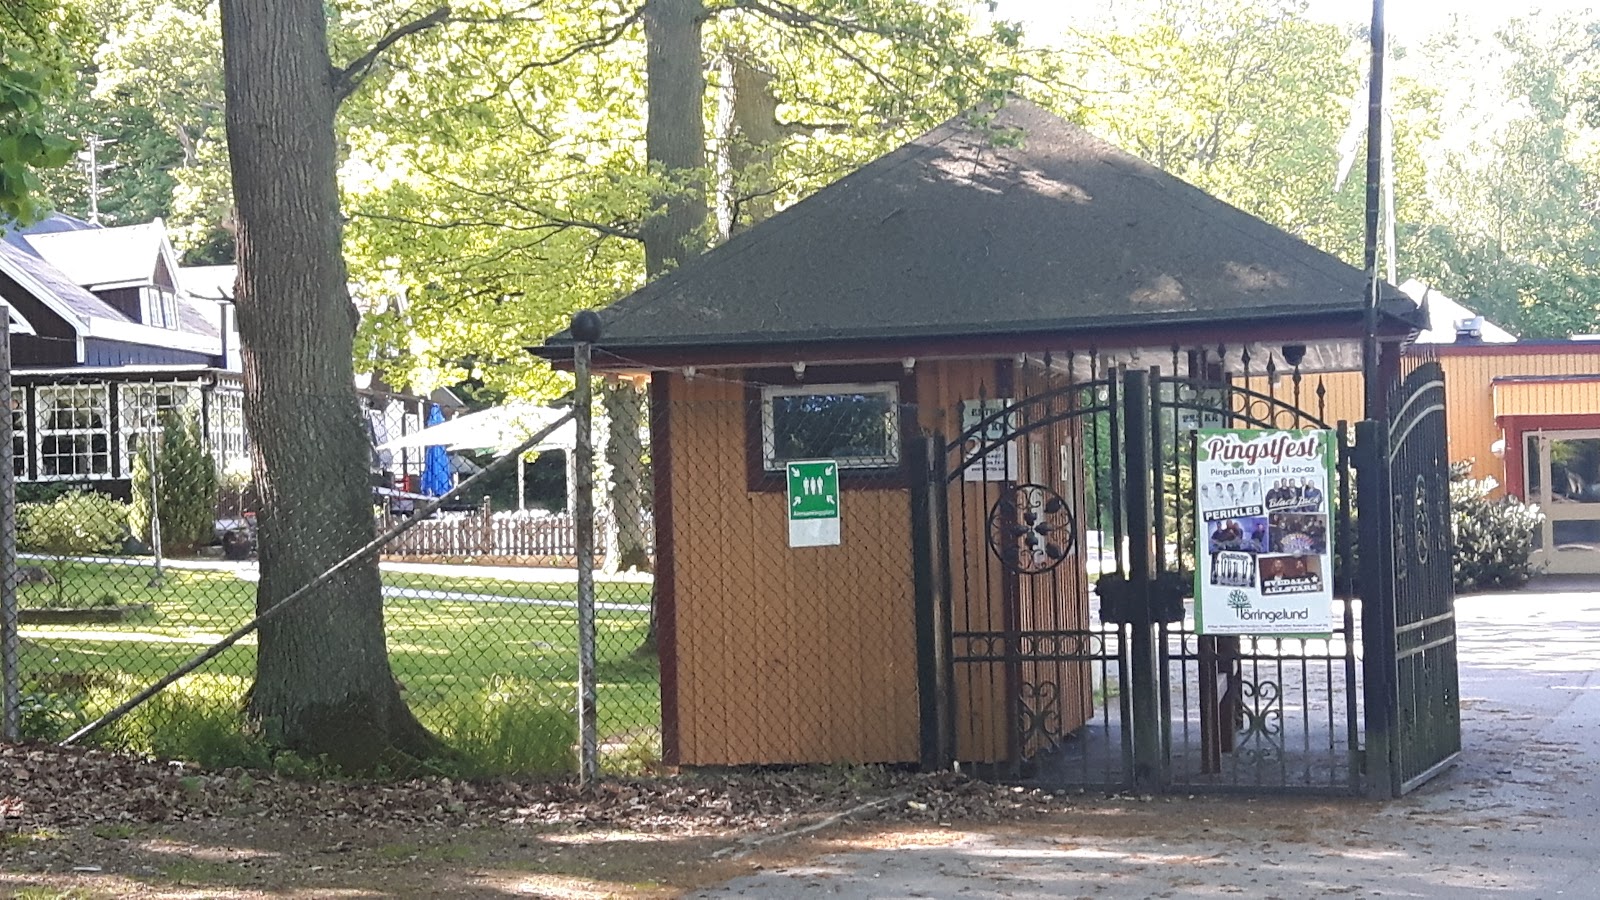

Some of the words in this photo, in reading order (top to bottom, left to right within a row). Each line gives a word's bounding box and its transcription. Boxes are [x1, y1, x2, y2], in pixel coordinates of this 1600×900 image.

[1208, 435, 1316, 466] Pingstfest
[1210, 468, 1255, 477] Pingstafton
[1264, 465, 1280, 475] juni
[1269, 497, 1297, 507] Black
[1205, 507, 1260, 520] PERIKLES
[1264, 578, 1310, 587] SVEDALA
[1264, 584, 1317, 594] ALLSTARS
